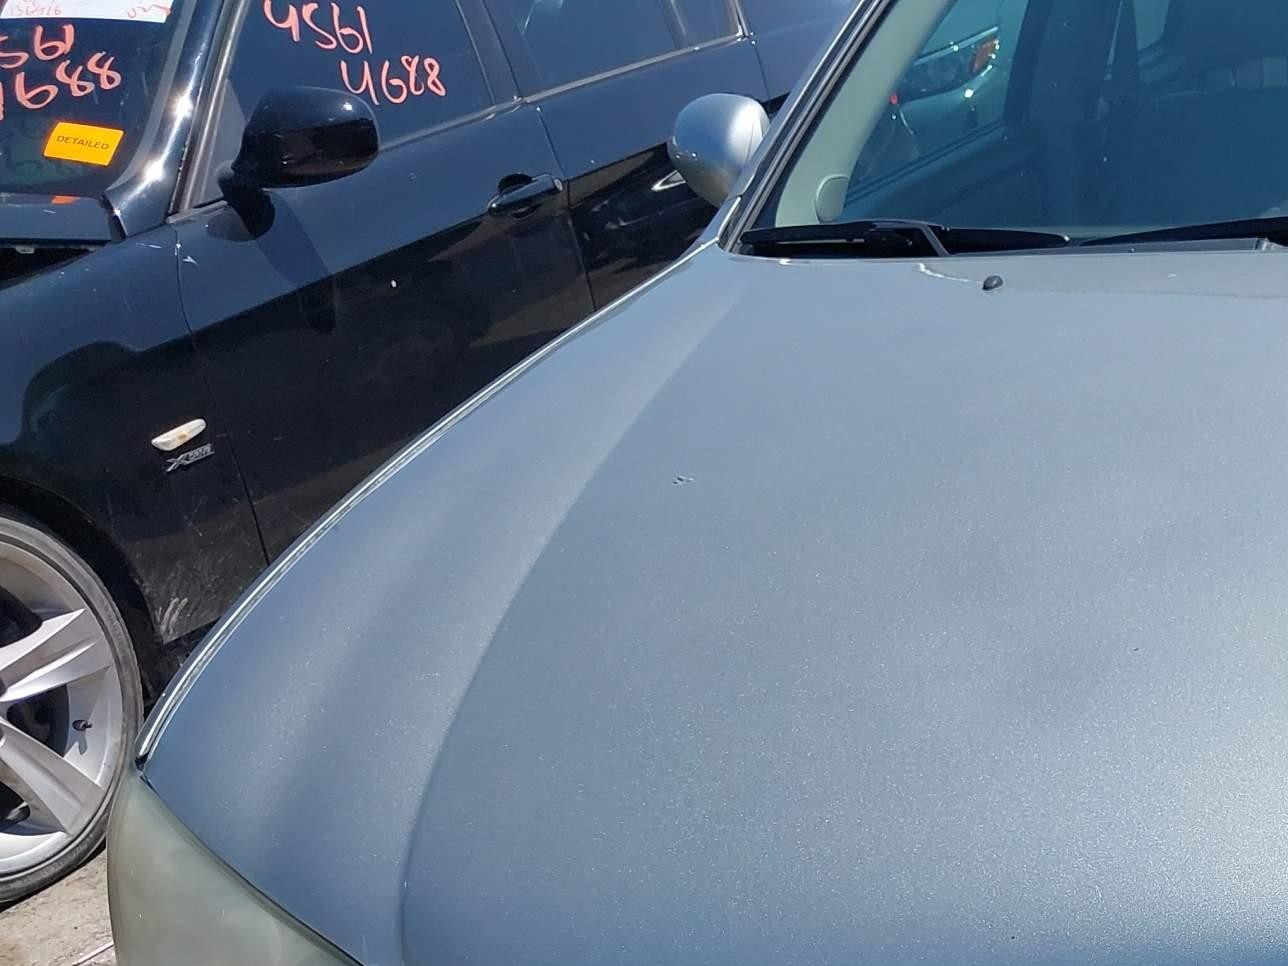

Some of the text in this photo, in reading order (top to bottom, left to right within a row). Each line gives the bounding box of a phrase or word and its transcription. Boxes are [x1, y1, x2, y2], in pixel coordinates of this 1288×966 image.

[0, 51, 122, 121] 688
[341, 55, 447, 105] 4688
[56, 135, 110, 150] DETAILED
